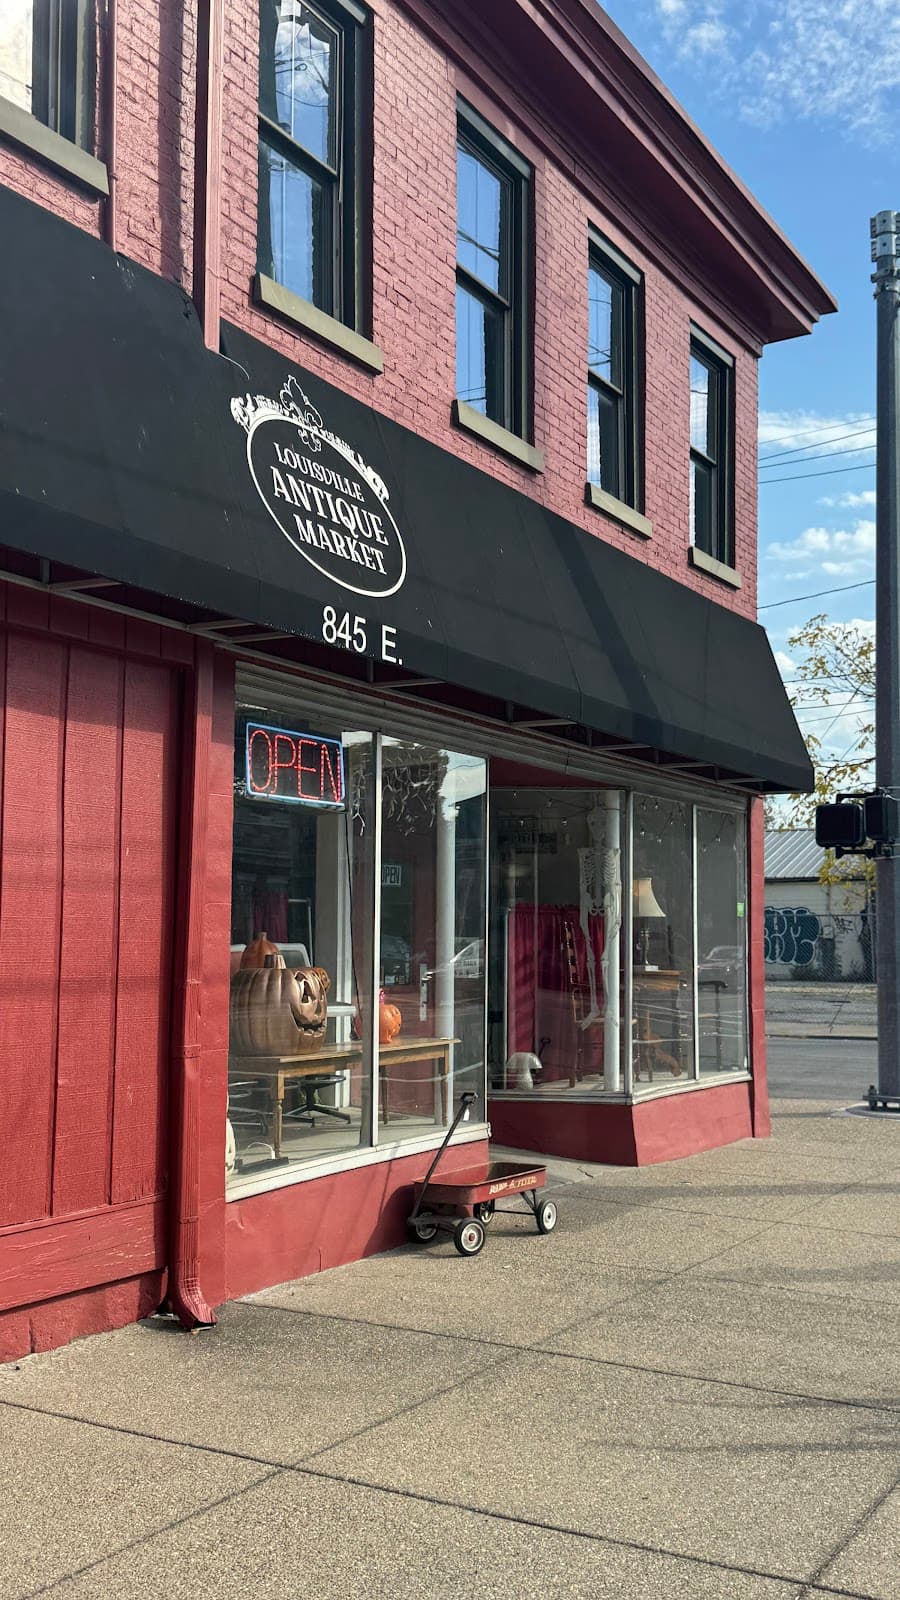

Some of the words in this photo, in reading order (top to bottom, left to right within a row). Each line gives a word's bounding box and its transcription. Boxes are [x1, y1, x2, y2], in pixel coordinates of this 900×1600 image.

[273, 442, 365, 503] LOUISVILLE
[270, 466, 389, 546] ANTIQUE
[293, 513, 388, 575] MARKET
[322, 605, 367, 653] 845
[381, 624, 403, 665] E.
[249, 729, 341, 802] OPEN
